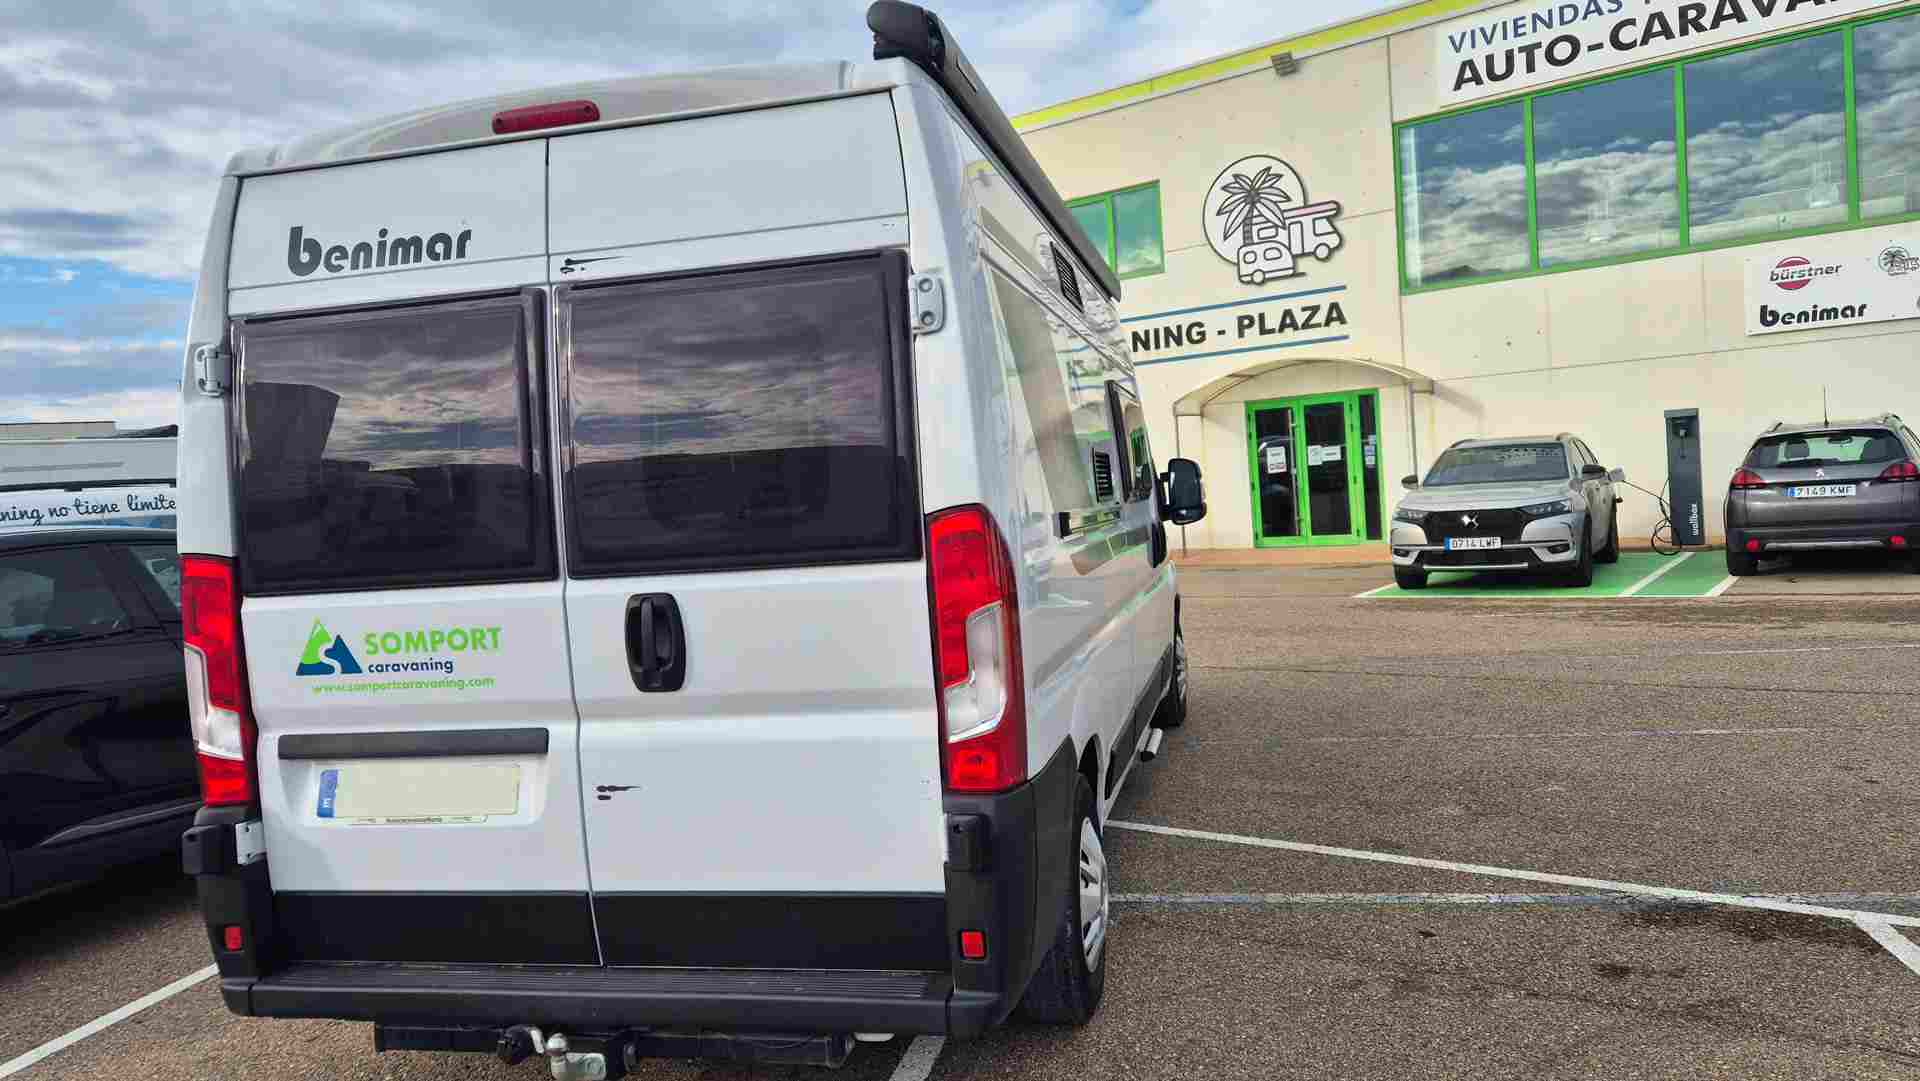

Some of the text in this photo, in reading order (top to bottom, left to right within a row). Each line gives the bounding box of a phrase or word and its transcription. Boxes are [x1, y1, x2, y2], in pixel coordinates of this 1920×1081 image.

[1448, 0, 1623, 54] VIVIENDAS
[288, 226, 472, 277] benimar
[1770, 264, 1843, 282] bürstner
[1131, 322, 1207, 352] NING
[1237, 302, 1348, 338] PLAZA
[1760, 304, 1868, 327] benimar
[48, 506, 69, 517] no
[73, 498, 120, 515] tiene
[1687, 503, 1699, 536] wallbox
[365, 627, 502, 655] SOMPORT
[368, 658, 454, 673] caravaning
[311, 677, 495, 695] www.somportcaravaning.com
